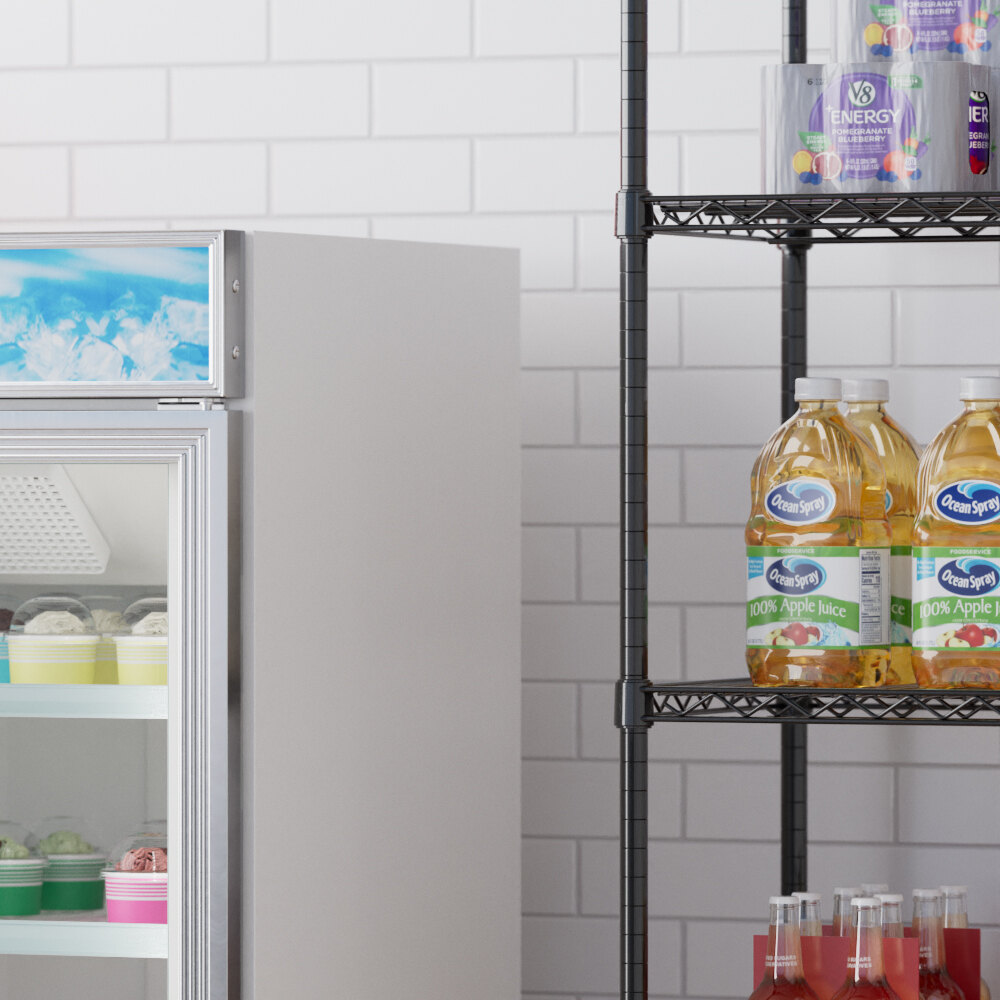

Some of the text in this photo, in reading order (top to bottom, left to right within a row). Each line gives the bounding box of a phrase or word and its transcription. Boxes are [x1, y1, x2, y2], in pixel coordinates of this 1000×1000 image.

[909, 8, 956, 16] BLUEBERRY
[848, 79, 873, 104] V8
[831, 127, 893, 136] POMEGRANATE
[838, 135, 886, 143] BLUEBERRY
[771, 493, 826, 517] Ocean Spray
[941, 493, 1000, 517] Ocean Spray
[769, 567, 820, 590] Ocean Spray
[941, 568, 996, 592] Ocean Spray
[750, 597, 847, 619] 100% Apple Juice
[919, 600, 951, 619] 100%
[952, 598, 993, 618] Apple
